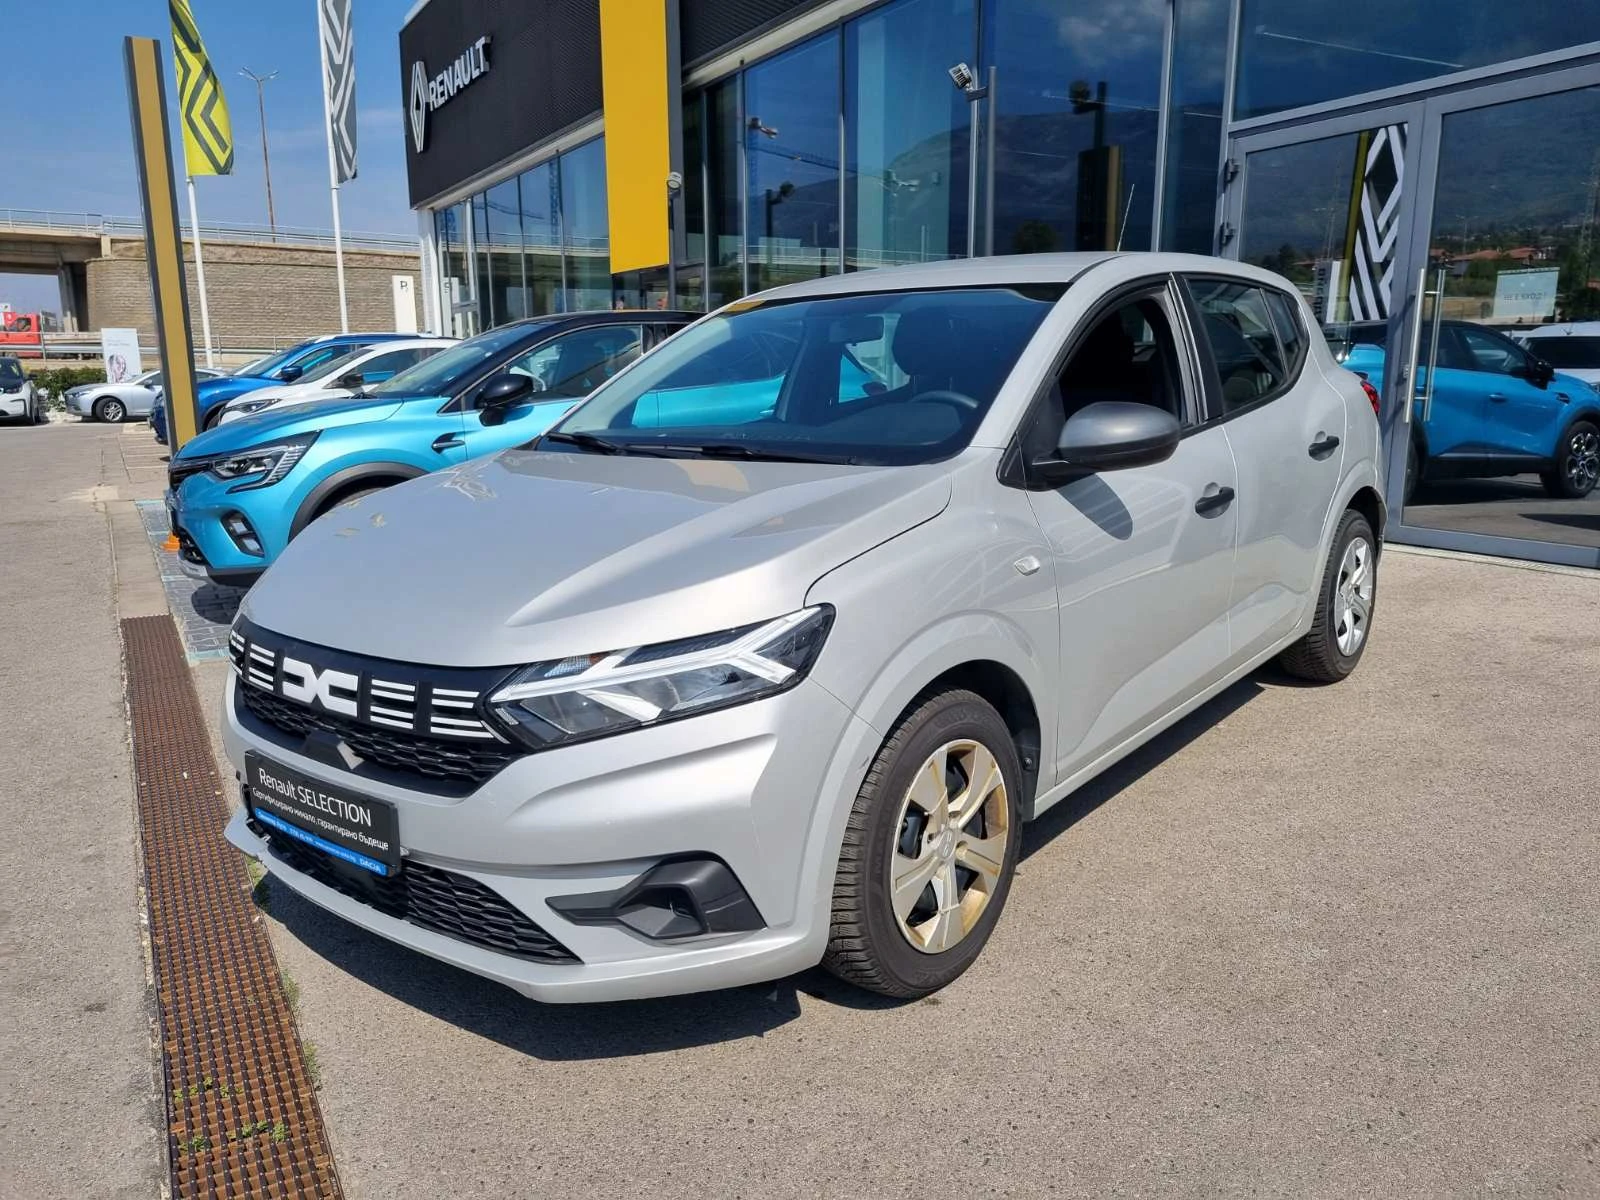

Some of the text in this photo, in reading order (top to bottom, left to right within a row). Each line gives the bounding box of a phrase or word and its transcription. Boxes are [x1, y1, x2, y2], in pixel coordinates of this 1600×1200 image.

[428, 35, 491, 112] RENAULT
[258, 767, 297, 801] Renault
[297, 785, 372, 828] SELECTION
[317, 818, 358, 841] гарантирано
[358, 832, 389, 851] бъдеще
